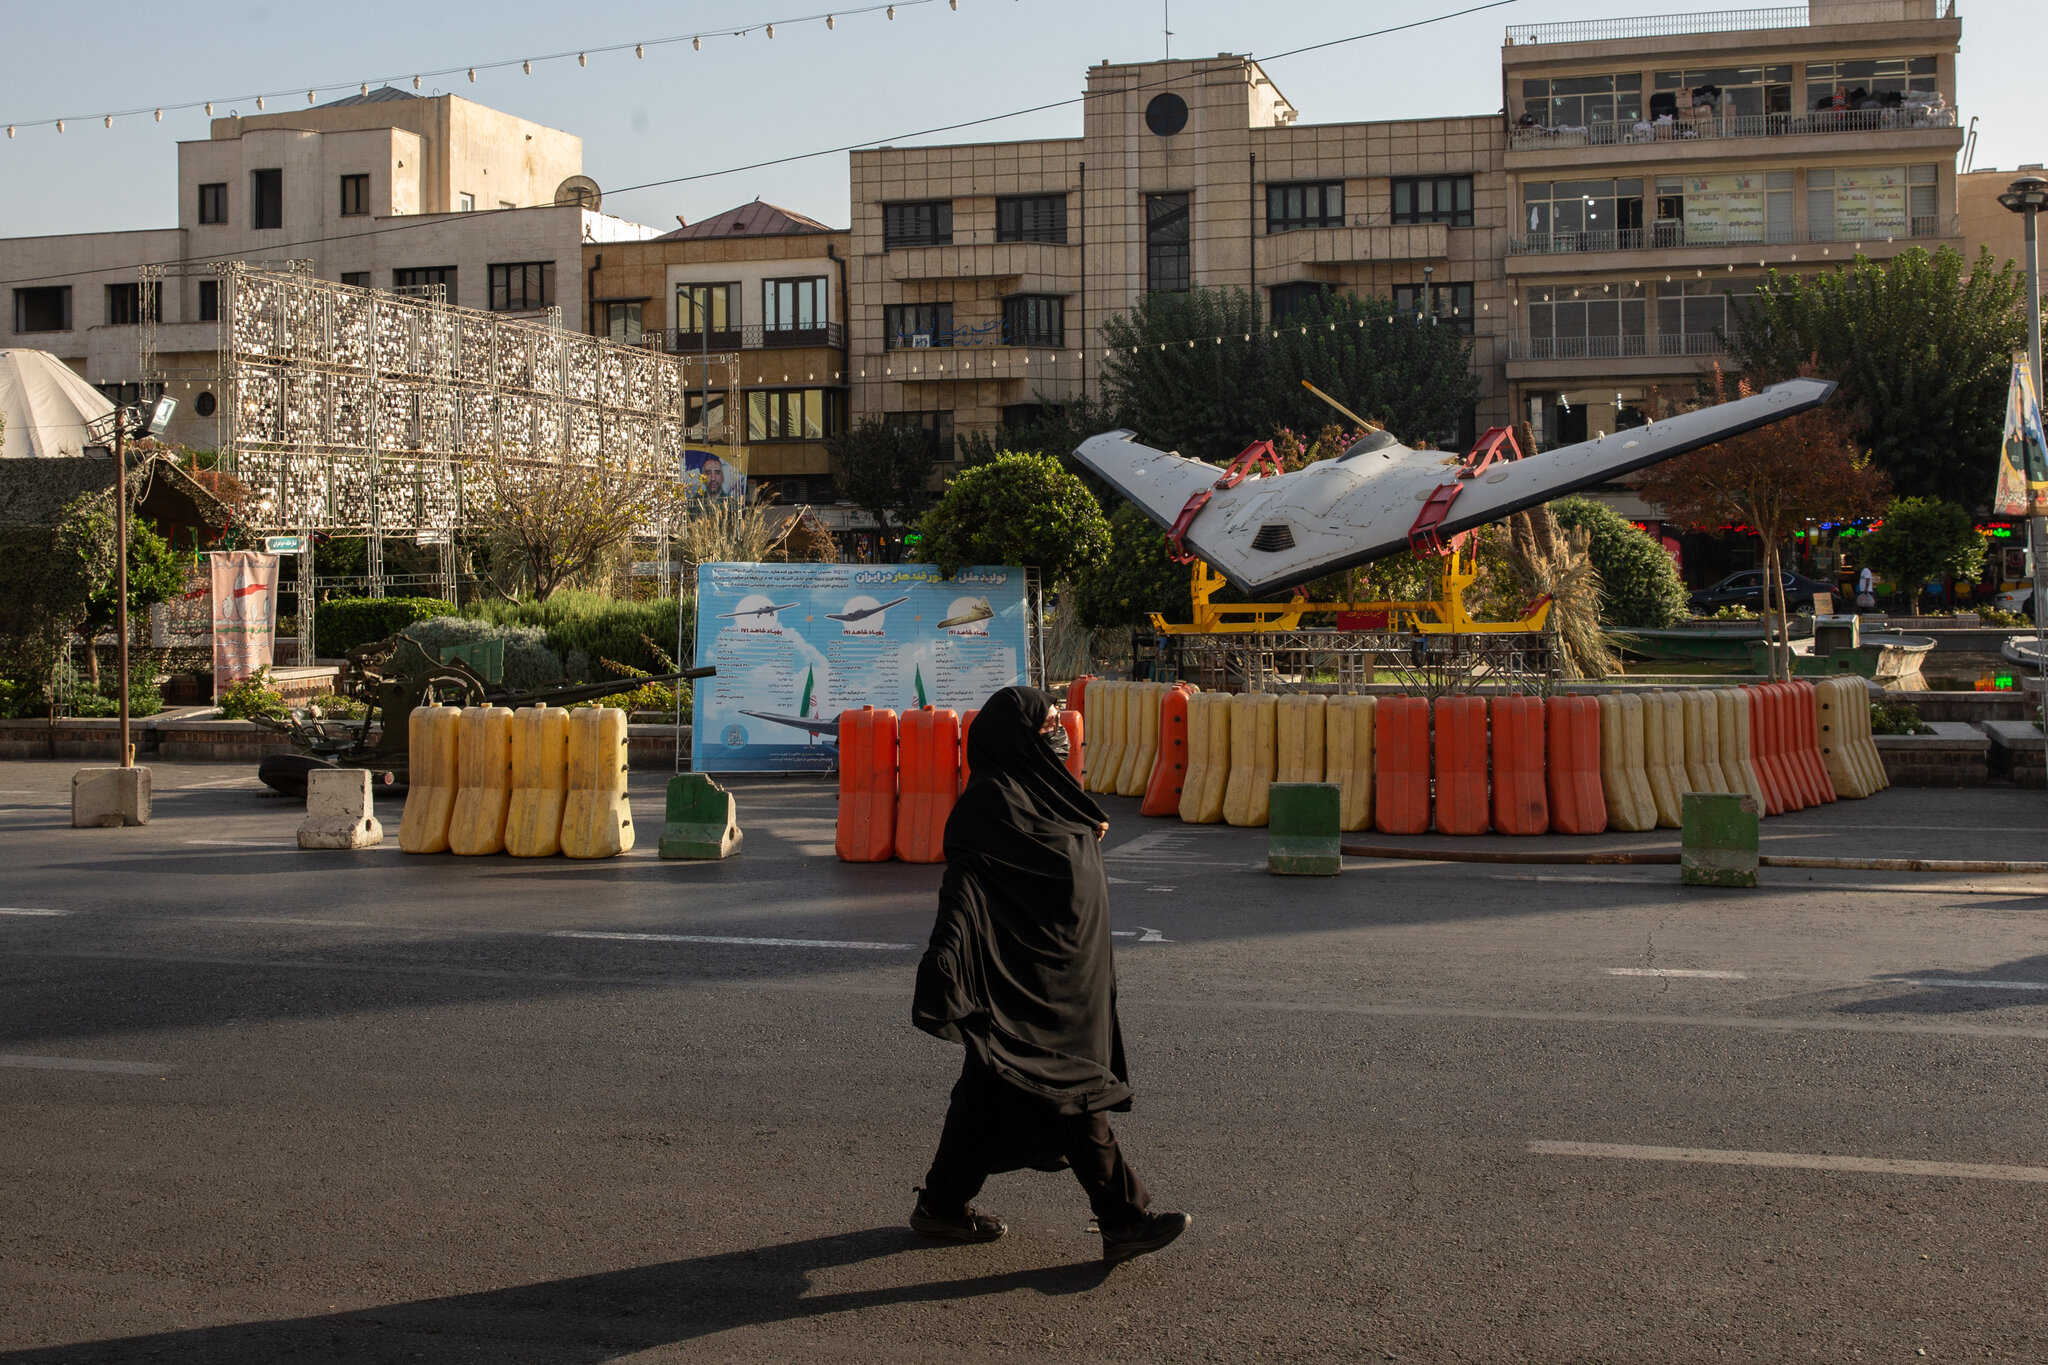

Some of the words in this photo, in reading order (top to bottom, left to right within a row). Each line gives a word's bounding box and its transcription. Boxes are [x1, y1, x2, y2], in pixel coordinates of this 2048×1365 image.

[856, 572, 880, 583] ایران
[892, 572, 926, 583] قندهار
[959, 572, 979, 584] مثل
[980, 573, 1007, 584] تولید
